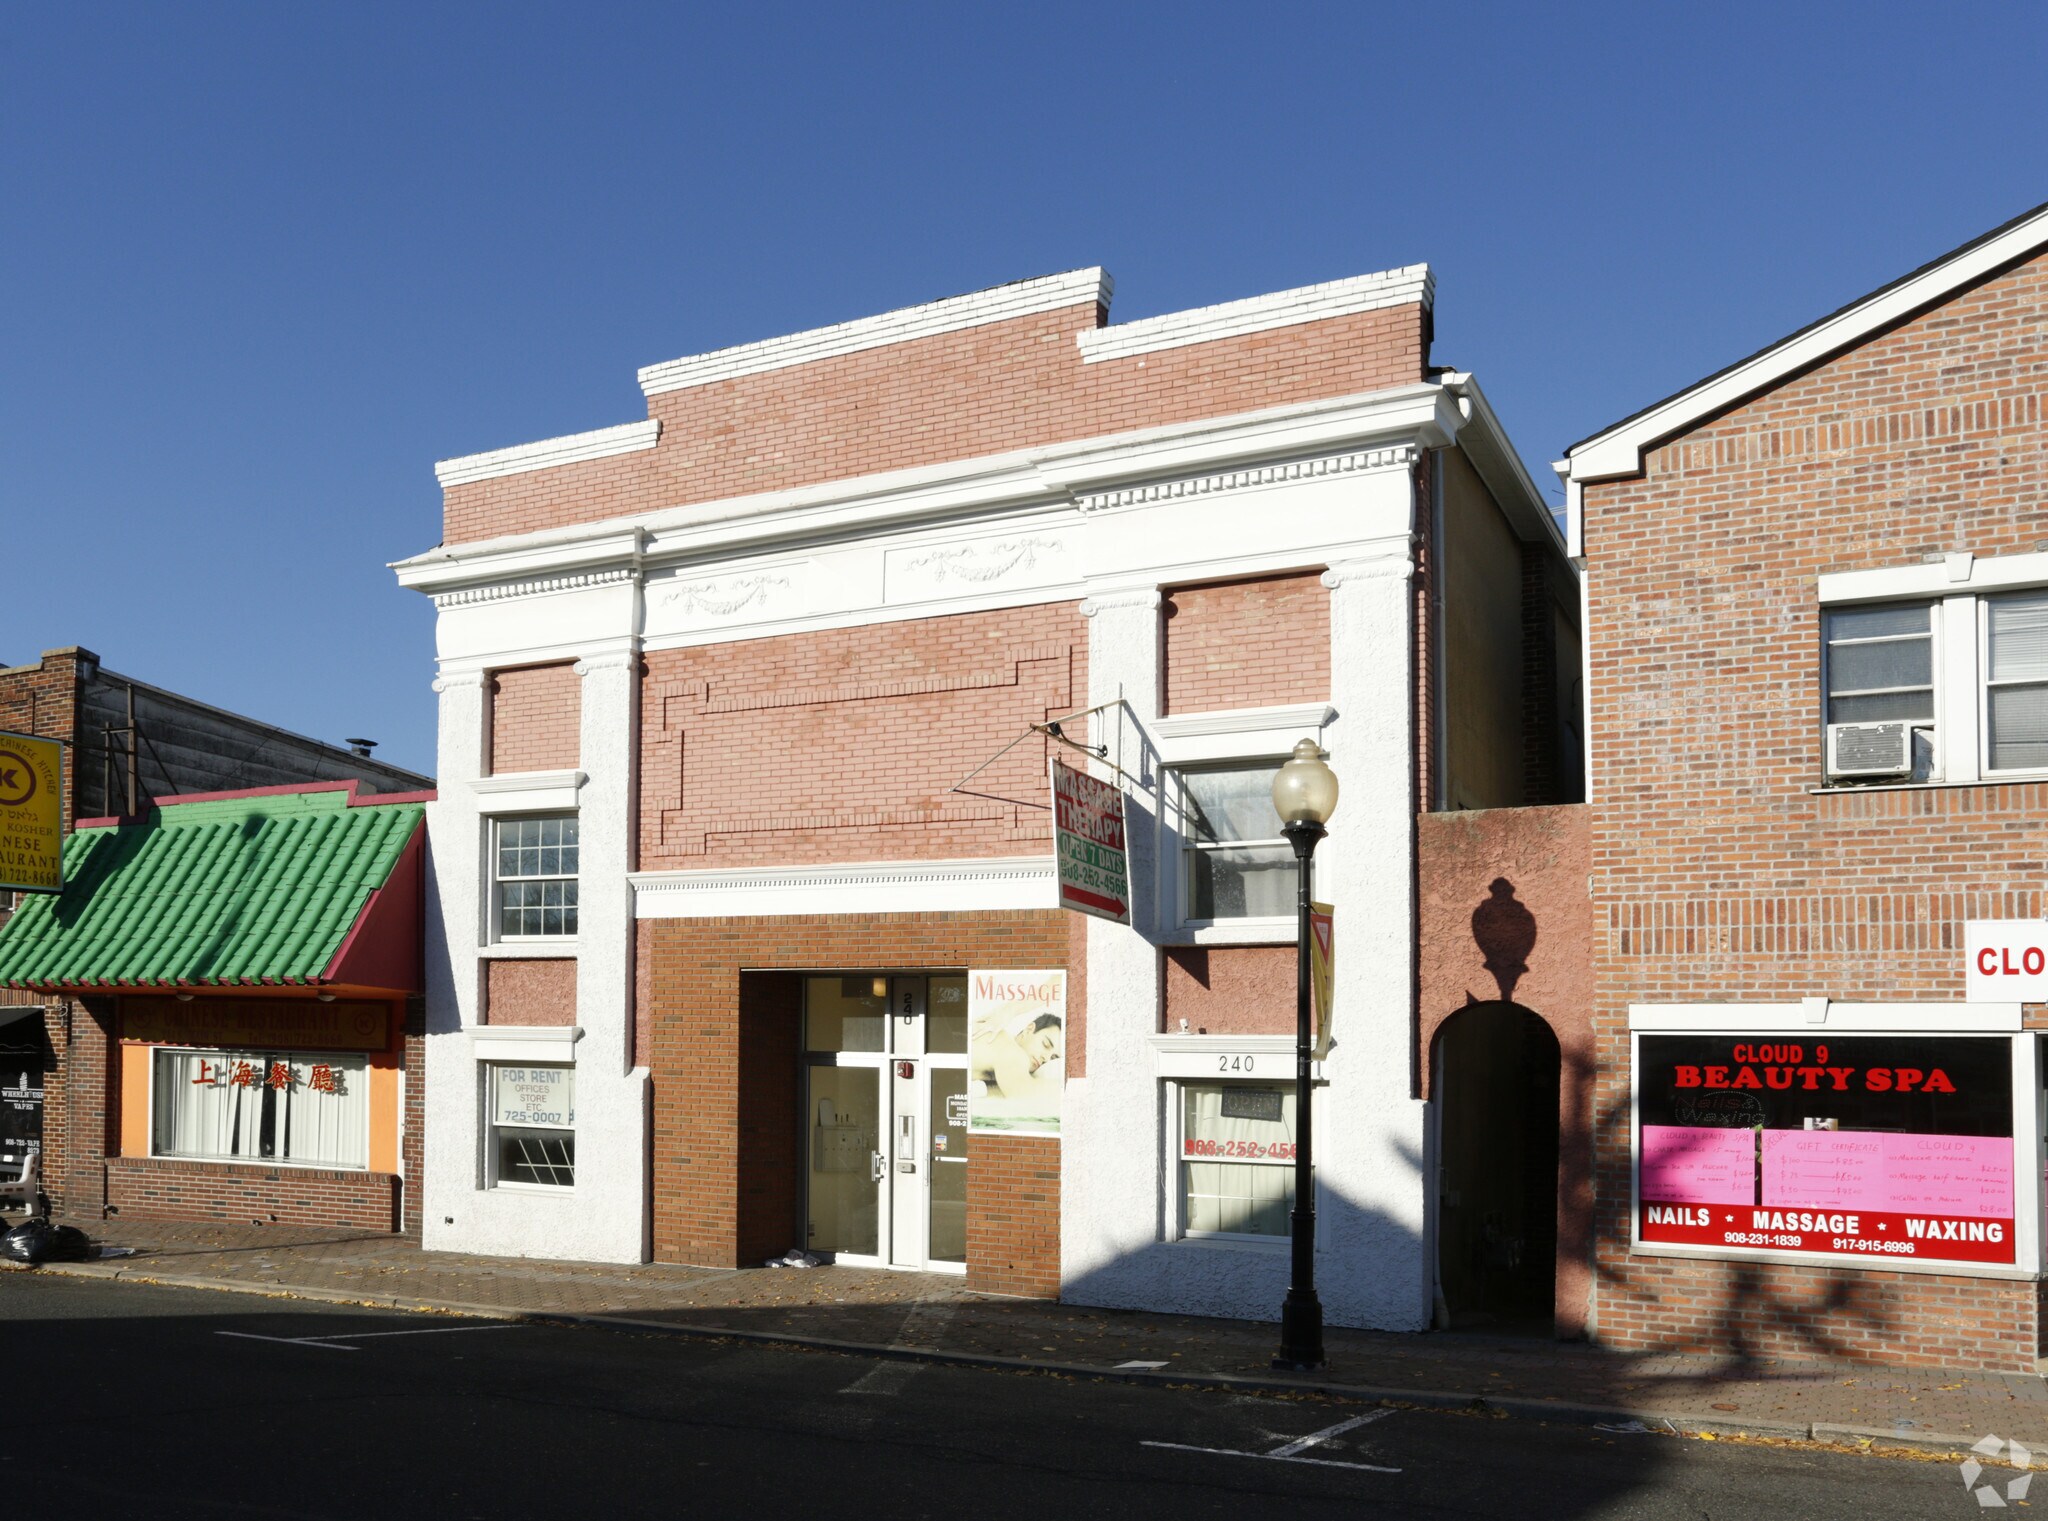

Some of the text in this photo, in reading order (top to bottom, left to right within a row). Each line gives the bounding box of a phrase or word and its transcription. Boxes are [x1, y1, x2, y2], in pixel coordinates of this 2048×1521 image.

[1055, 764, 1122, 818] MASSAGE
[8, 822, 53, 836] KOSHER
[1058, 797, 1122, 847] THERAPY
[1062, 834, 1124, 874] OPEN 7 DAYS
[10, 868, 58, 886] 722-8668
[1977, 947, 2045, 976] CLO
[975, 975, 1061, 1007] MASSAGE
[903, 993, 913, 1026] 240
[1219, 1055, 1254, 1072] 240
[1733, 1043, 1828, 1064] CLOUD 9
[192, 1060, 335, 1092] 上海餐廳
[502, 1069, 562, 1084] FOR RENT
[1674, 1065, 1957, 1093] BEAUTY SPA
[1, 1090, 43, 1099] WHEELHUSE
[515, 1084, 550, 1093] OFFICES
[520, 1093, 547, 1103] STORE
[504, 1110, 562, 1123] 725-0007
[526, 1103, 544, 1112] ETC.
[1917, 1141, 1964, 1151] CLOUD
[1647, 1206, 2004, 1243] NAILS MASSAGE WAXING
[1724, 1231, 1916, 1255] 908-231-1839 917-915-6996
